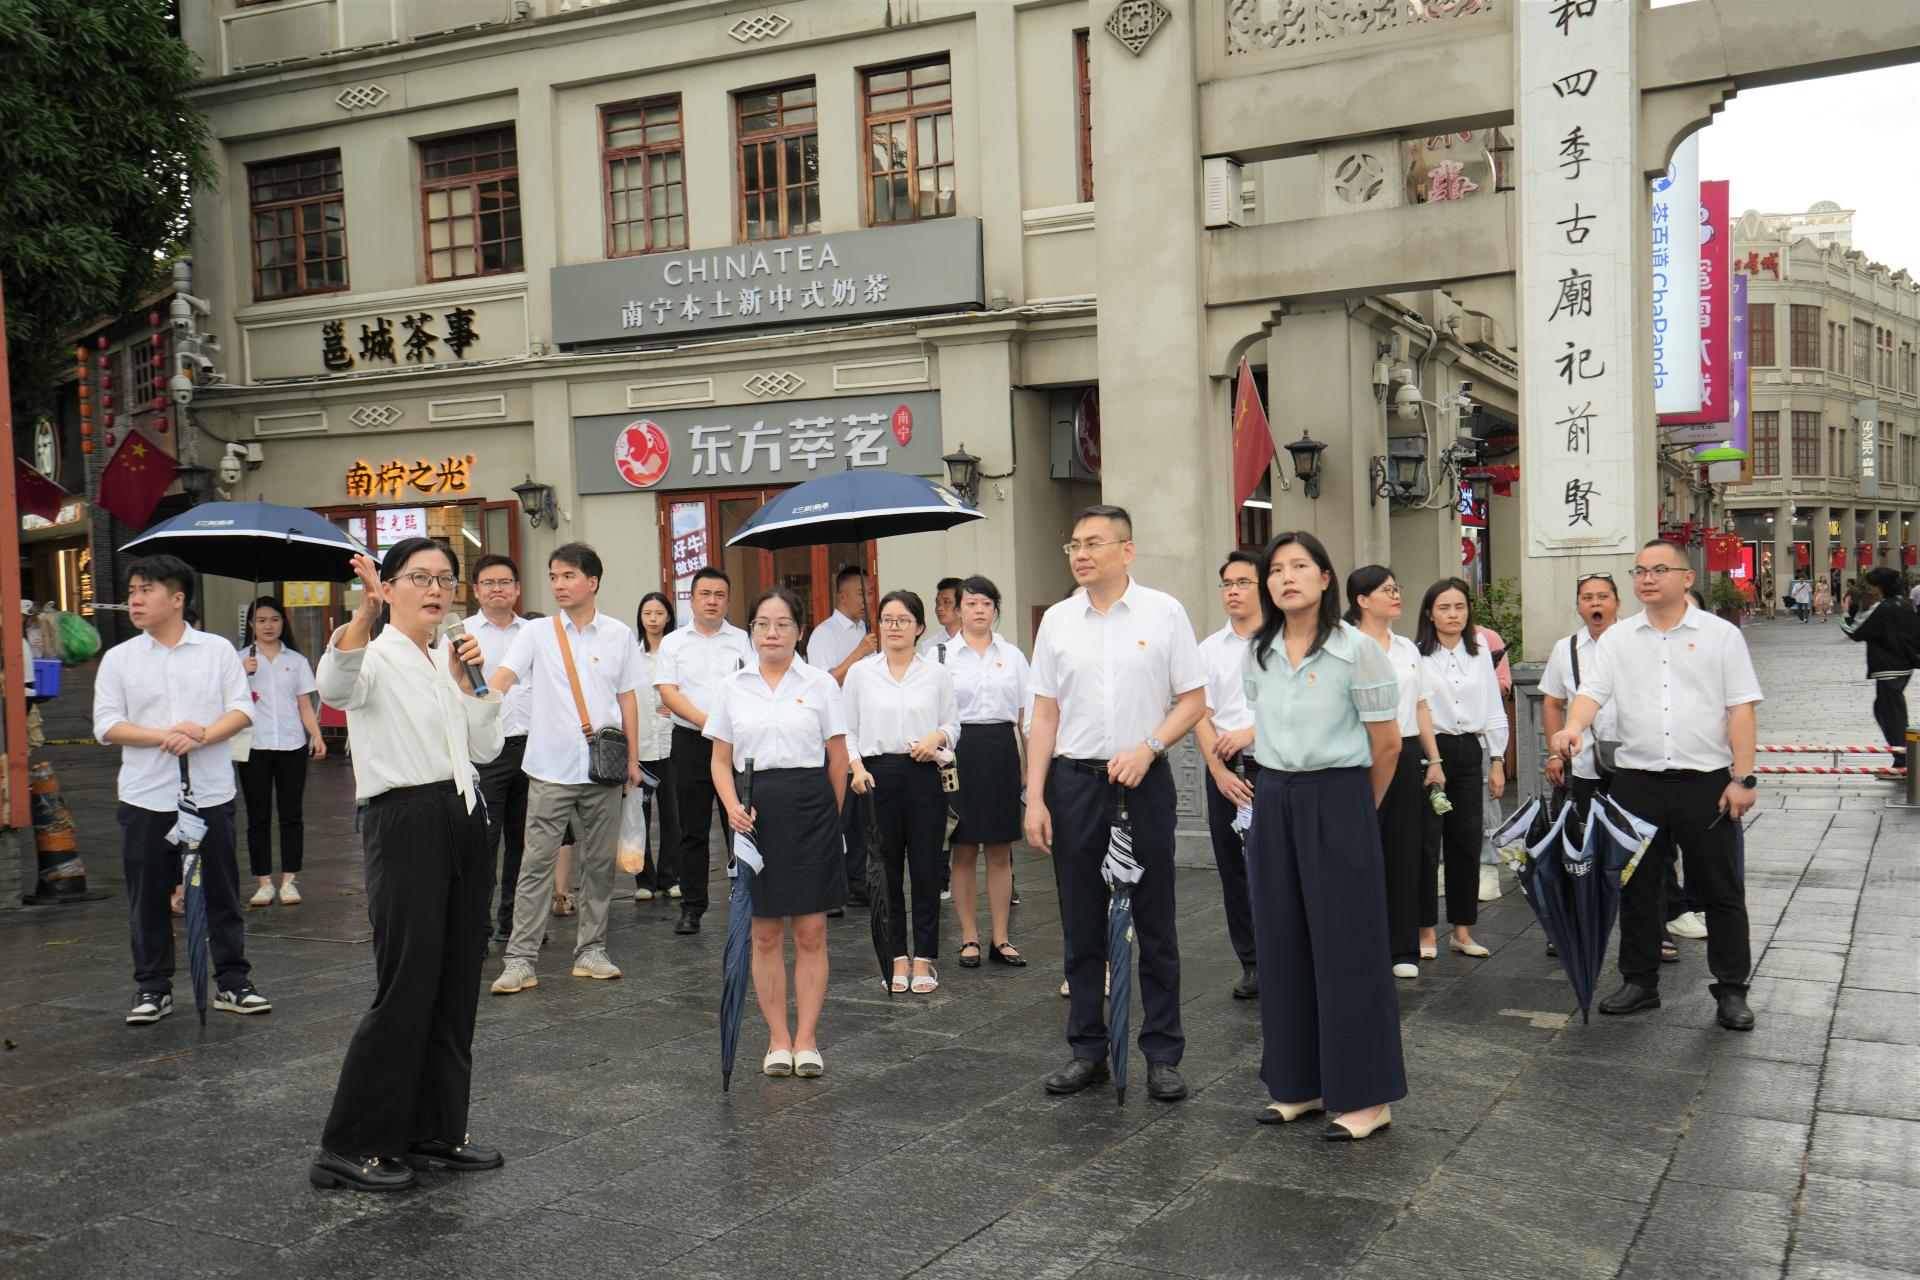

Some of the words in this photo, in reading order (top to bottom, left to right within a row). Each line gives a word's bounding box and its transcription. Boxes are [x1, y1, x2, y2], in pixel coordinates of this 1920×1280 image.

[663, 243, 840, 286] CHINATEA
[621, 273, 890, 329] 南宁本土新中式奶茶
[688, 412, 889, 476] 东方萃茗
[896, 410, 910, 441] 南宁
[346, 457, 466, 497] 南柠之光
[674, 531, 707, 561] 好牛
